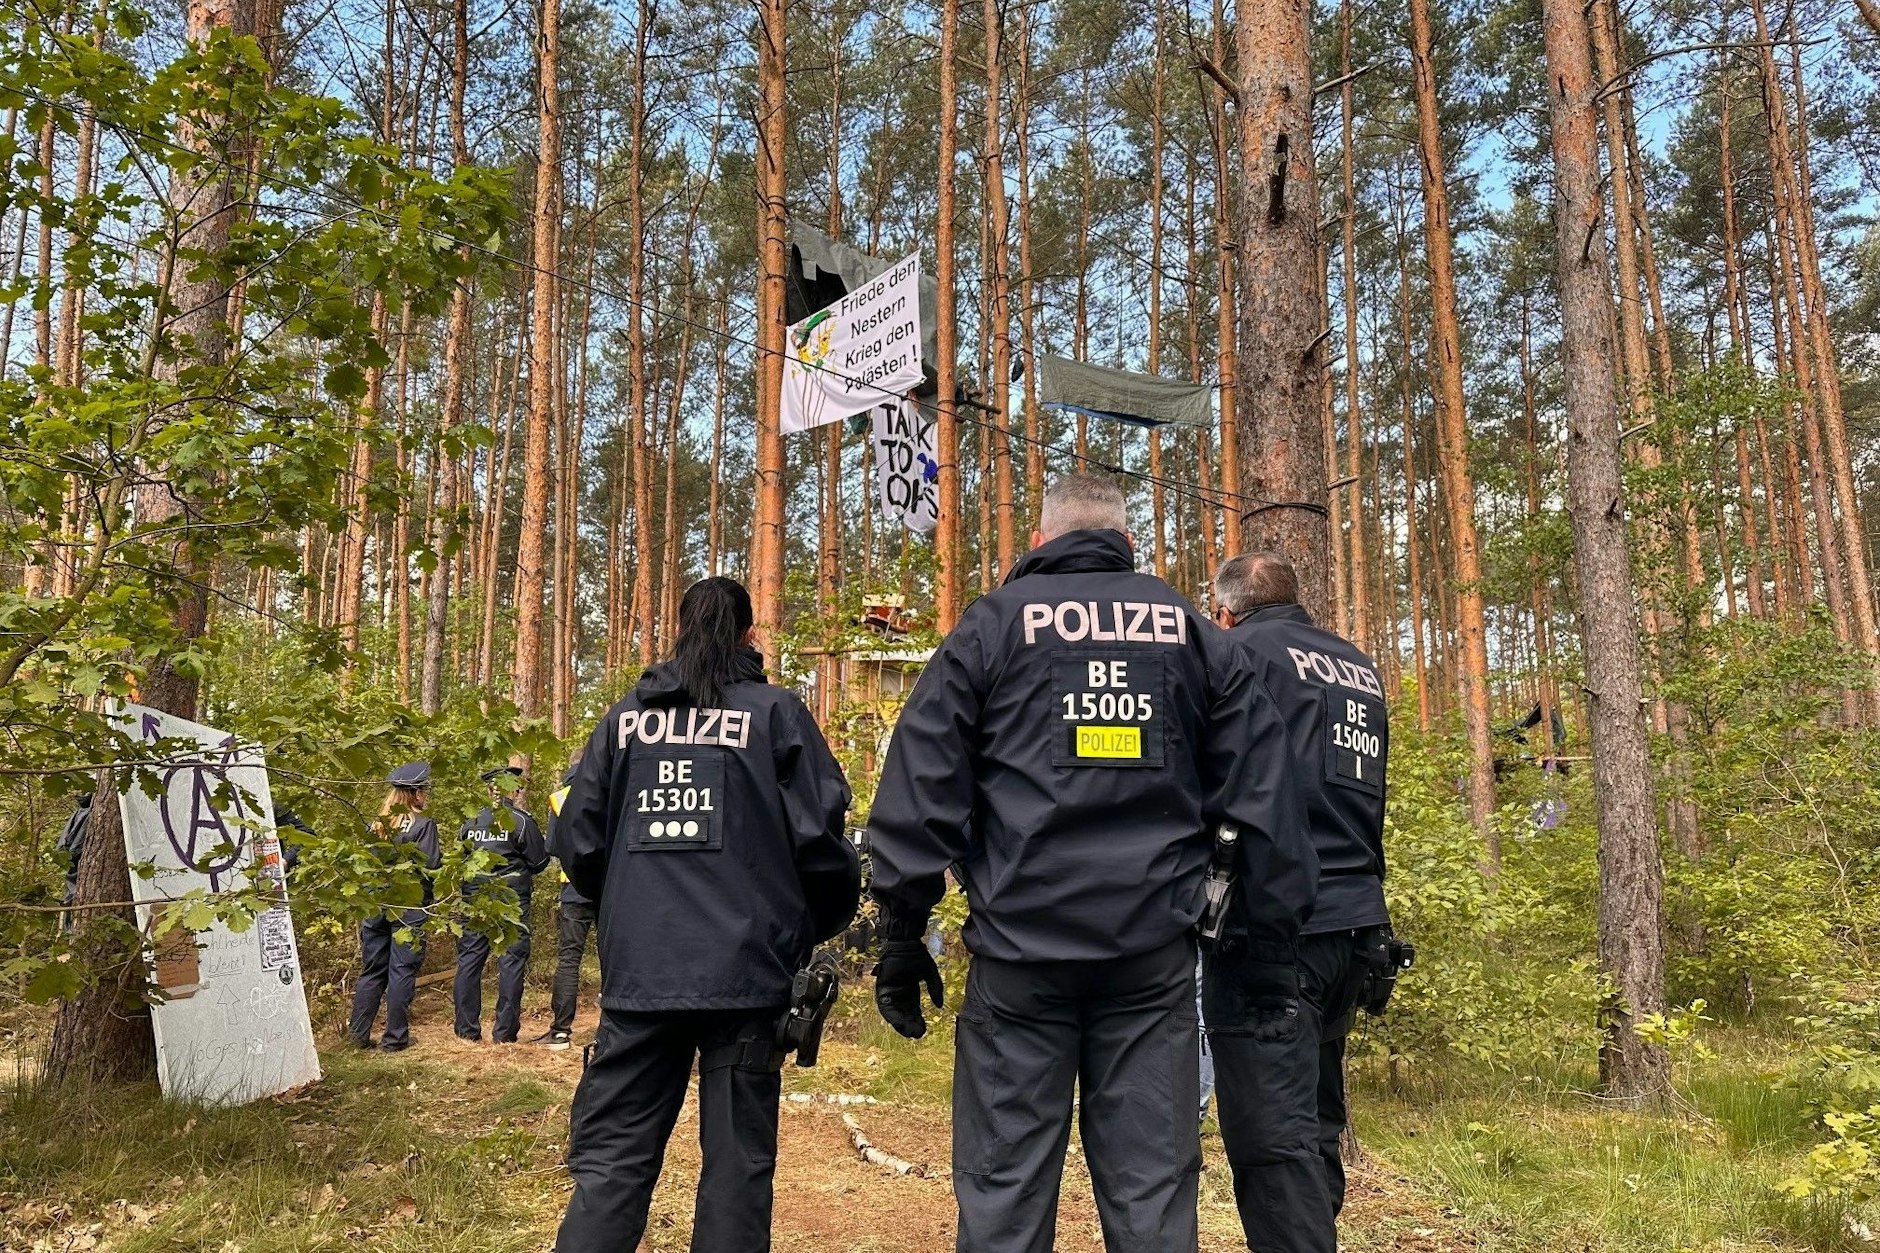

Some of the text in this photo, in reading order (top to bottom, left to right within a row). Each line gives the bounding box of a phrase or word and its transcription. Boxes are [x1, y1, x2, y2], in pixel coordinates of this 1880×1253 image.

[841, 260, 916, 316] Friede den
[851, 296, 906, 339] Nestern
[845, 321, 915, 369] Krieg den
[880, 440, 914, 474] TO
[1023, 600, 1187, 645] POLIZEI
[1088, 660, 1129, 688] BE
[1286, 646, 1383, 700] POLIZEI
[1062, 692, 1153, 722] 15005
[1346, 698, 1367, 728] BE
[618, 707, 751, 749] POLIZEI
[1081, 733, 1137, 753] POLIZEI
[1332, 722, 1379, 758] 15000
[658, 759, 693, 784] BE
[637, 788, 714, 812] 15301
